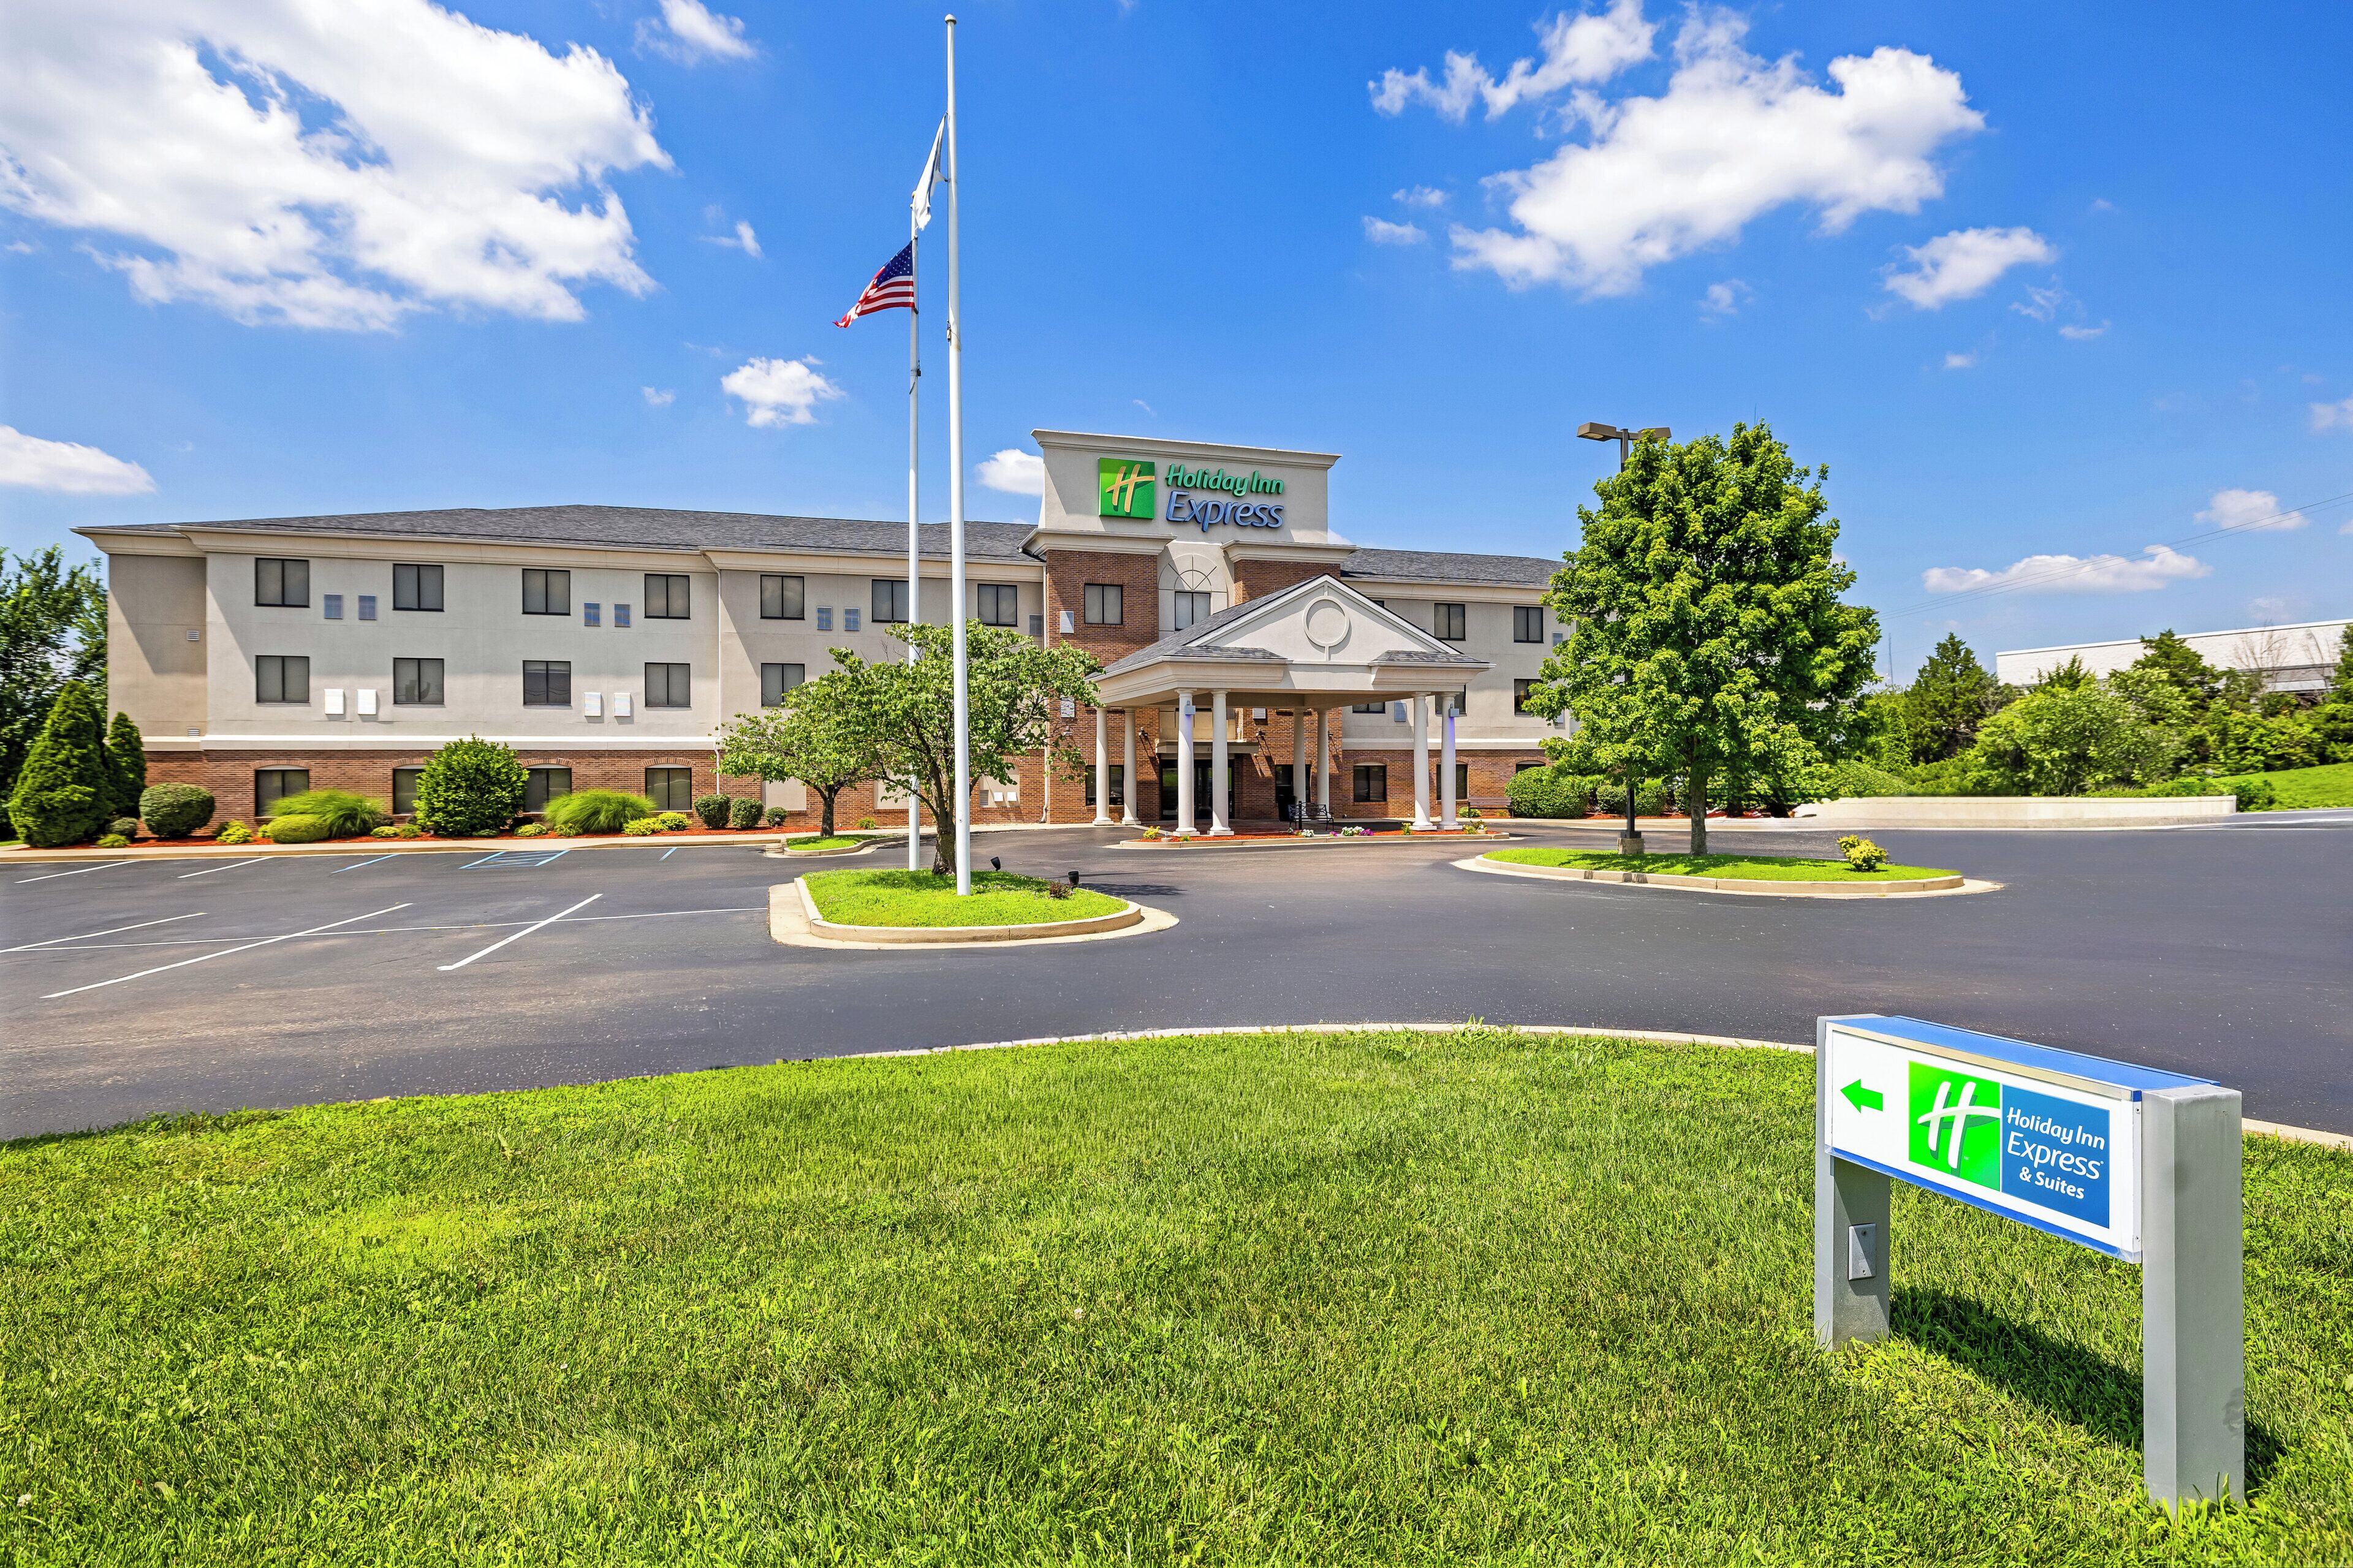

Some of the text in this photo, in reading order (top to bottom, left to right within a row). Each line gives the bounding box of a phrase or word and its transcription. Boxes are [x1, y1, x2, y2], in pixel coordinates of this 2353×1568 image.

[1165, 463, 1284, 497] Holiday Inn
[1165, 490, 1284, 532] Express
[2006, 1107, 2105, 1150] Holiday Inn
[2007, 1131, 2101, 1180] Express
[2019, 1166, 2085, 1199] & Suites
